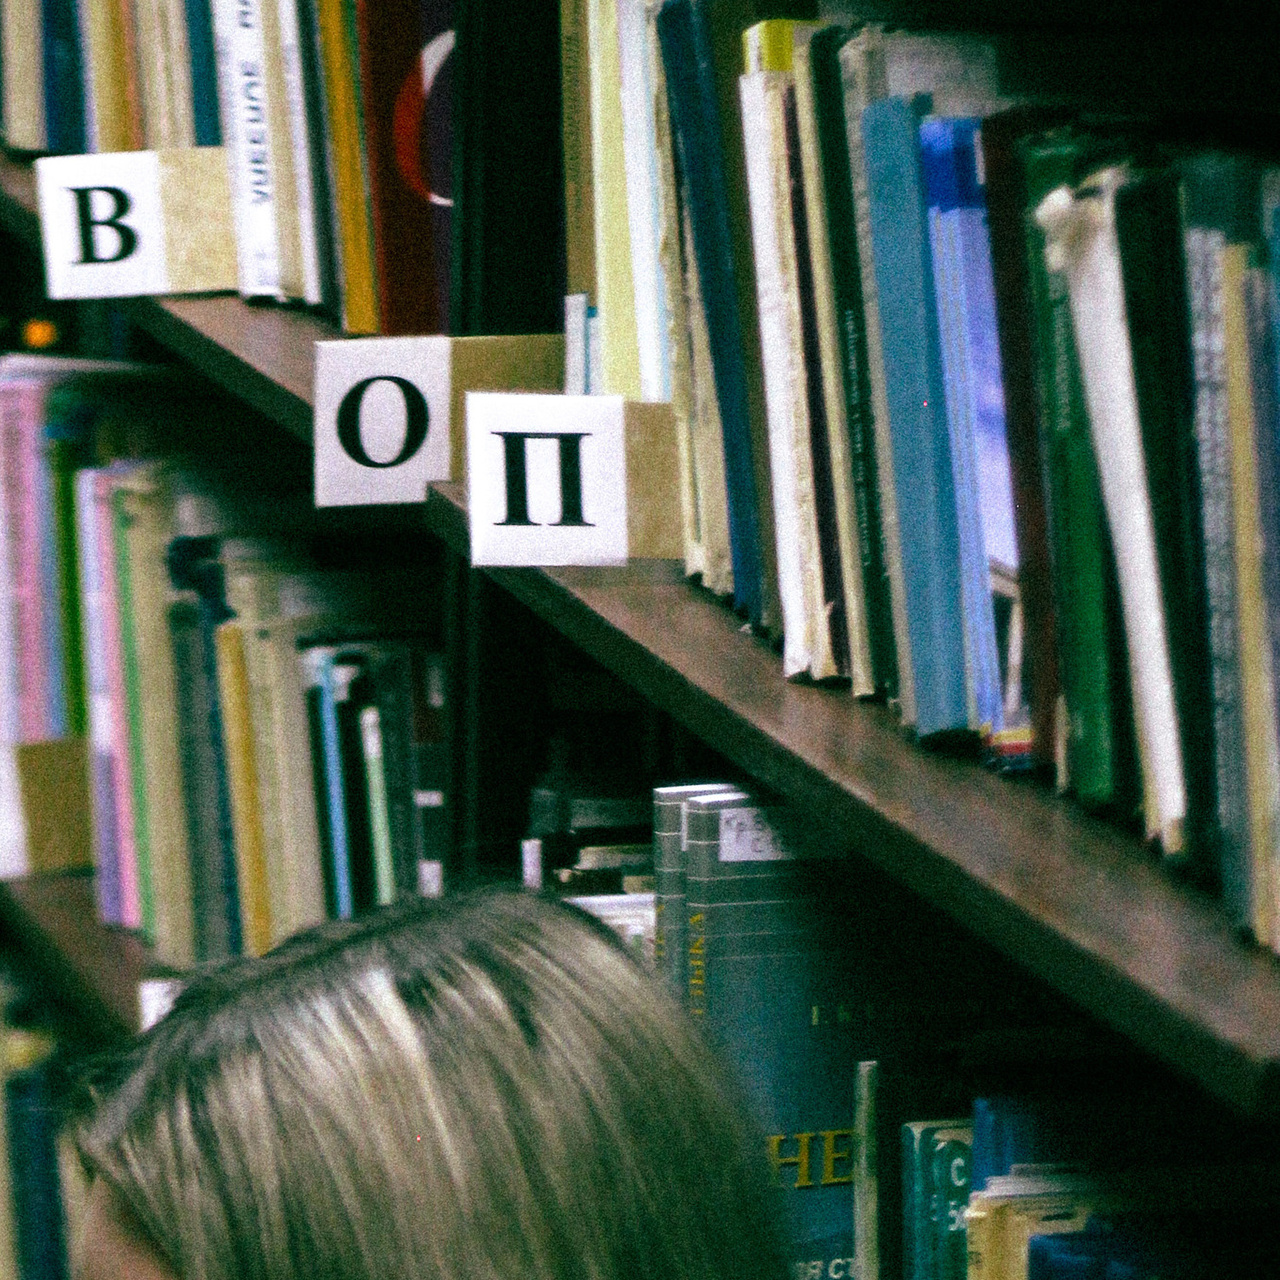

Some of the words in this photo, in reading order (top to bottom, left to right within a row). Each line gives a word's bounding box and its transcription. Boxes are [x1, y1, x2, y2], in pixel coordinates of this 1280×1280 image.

[66, 185, 140, 265] В
[336, 375, 430, 468] О
[491, 430, 596, 527] П
